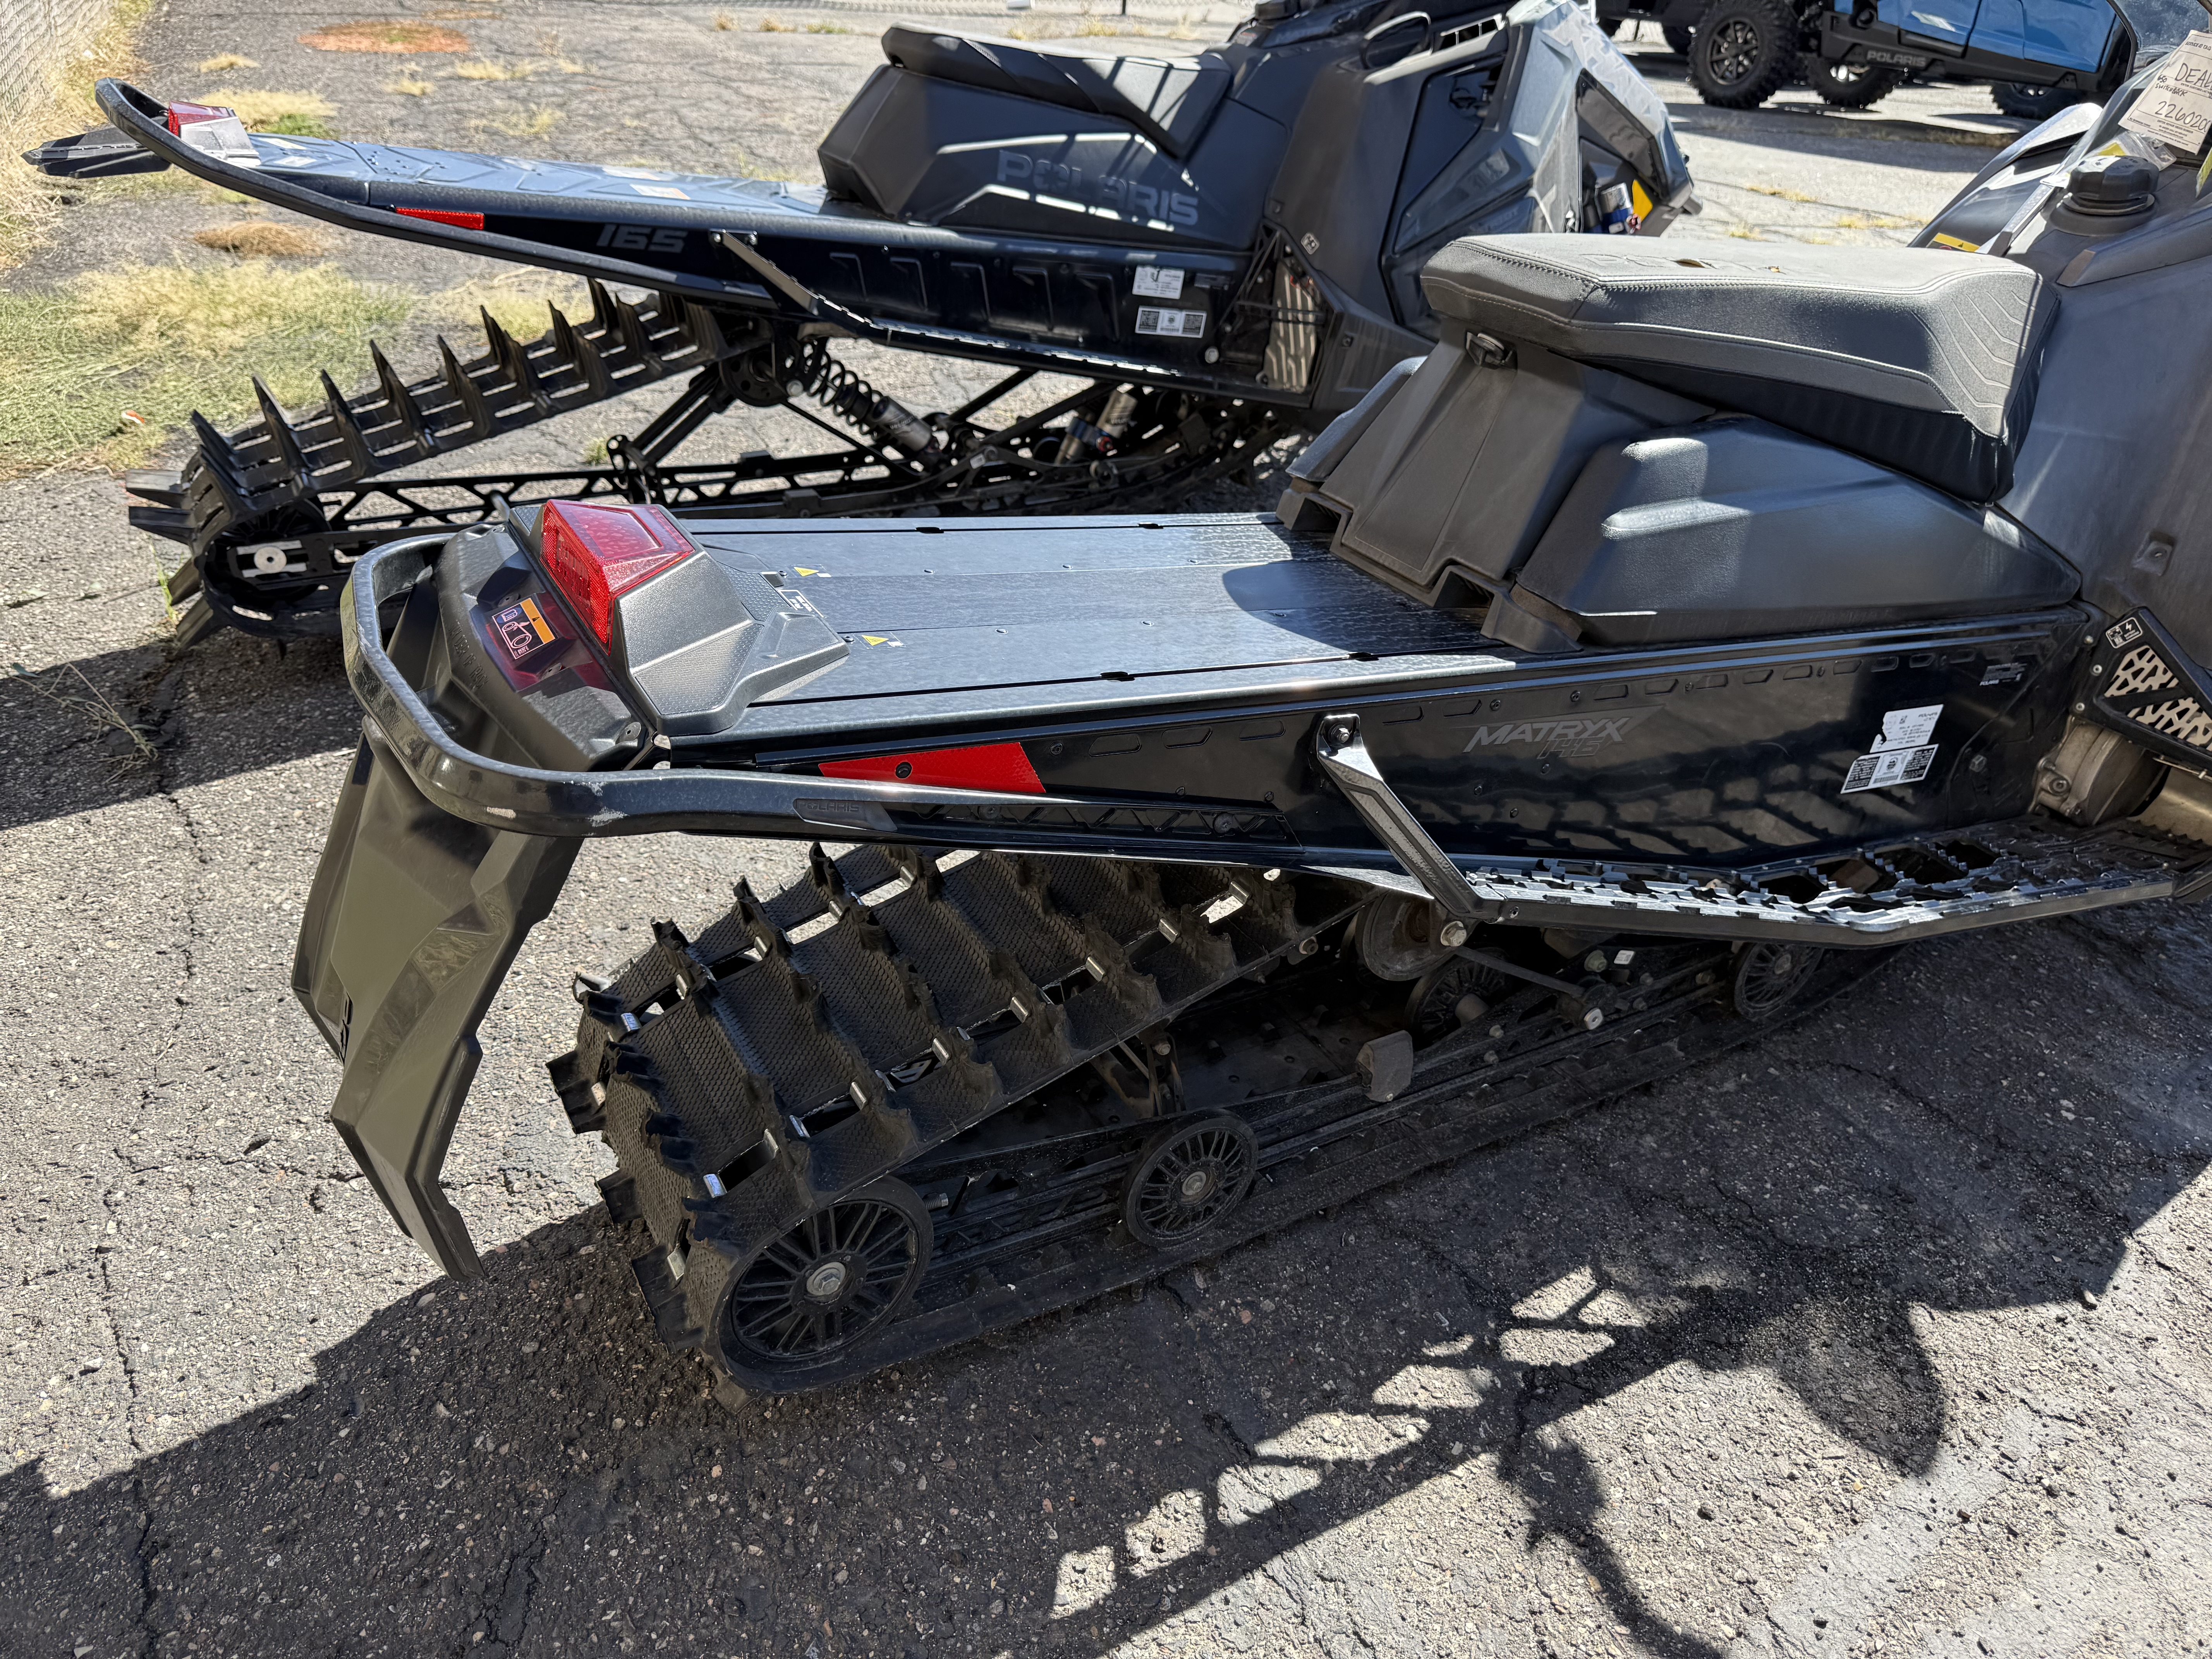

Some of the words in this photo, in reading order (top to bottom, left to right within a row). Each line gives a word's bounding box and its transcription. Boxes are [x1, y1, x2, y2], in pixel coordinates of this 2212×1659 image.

[1867, 50, 1926, 67] POLARIS
[2174, 62, 2212, 90] DEAL
[2155, 83, 2188, 97] SWITCHBACK
[996, 149, 1198, 225] POLARIS
[596, 223, 688, 253] 165
[1462, 717, 1630, 753] MATRYX
[1537, 736, 1606, 759] 146
[798, 802, 860, 812] POLARIS
